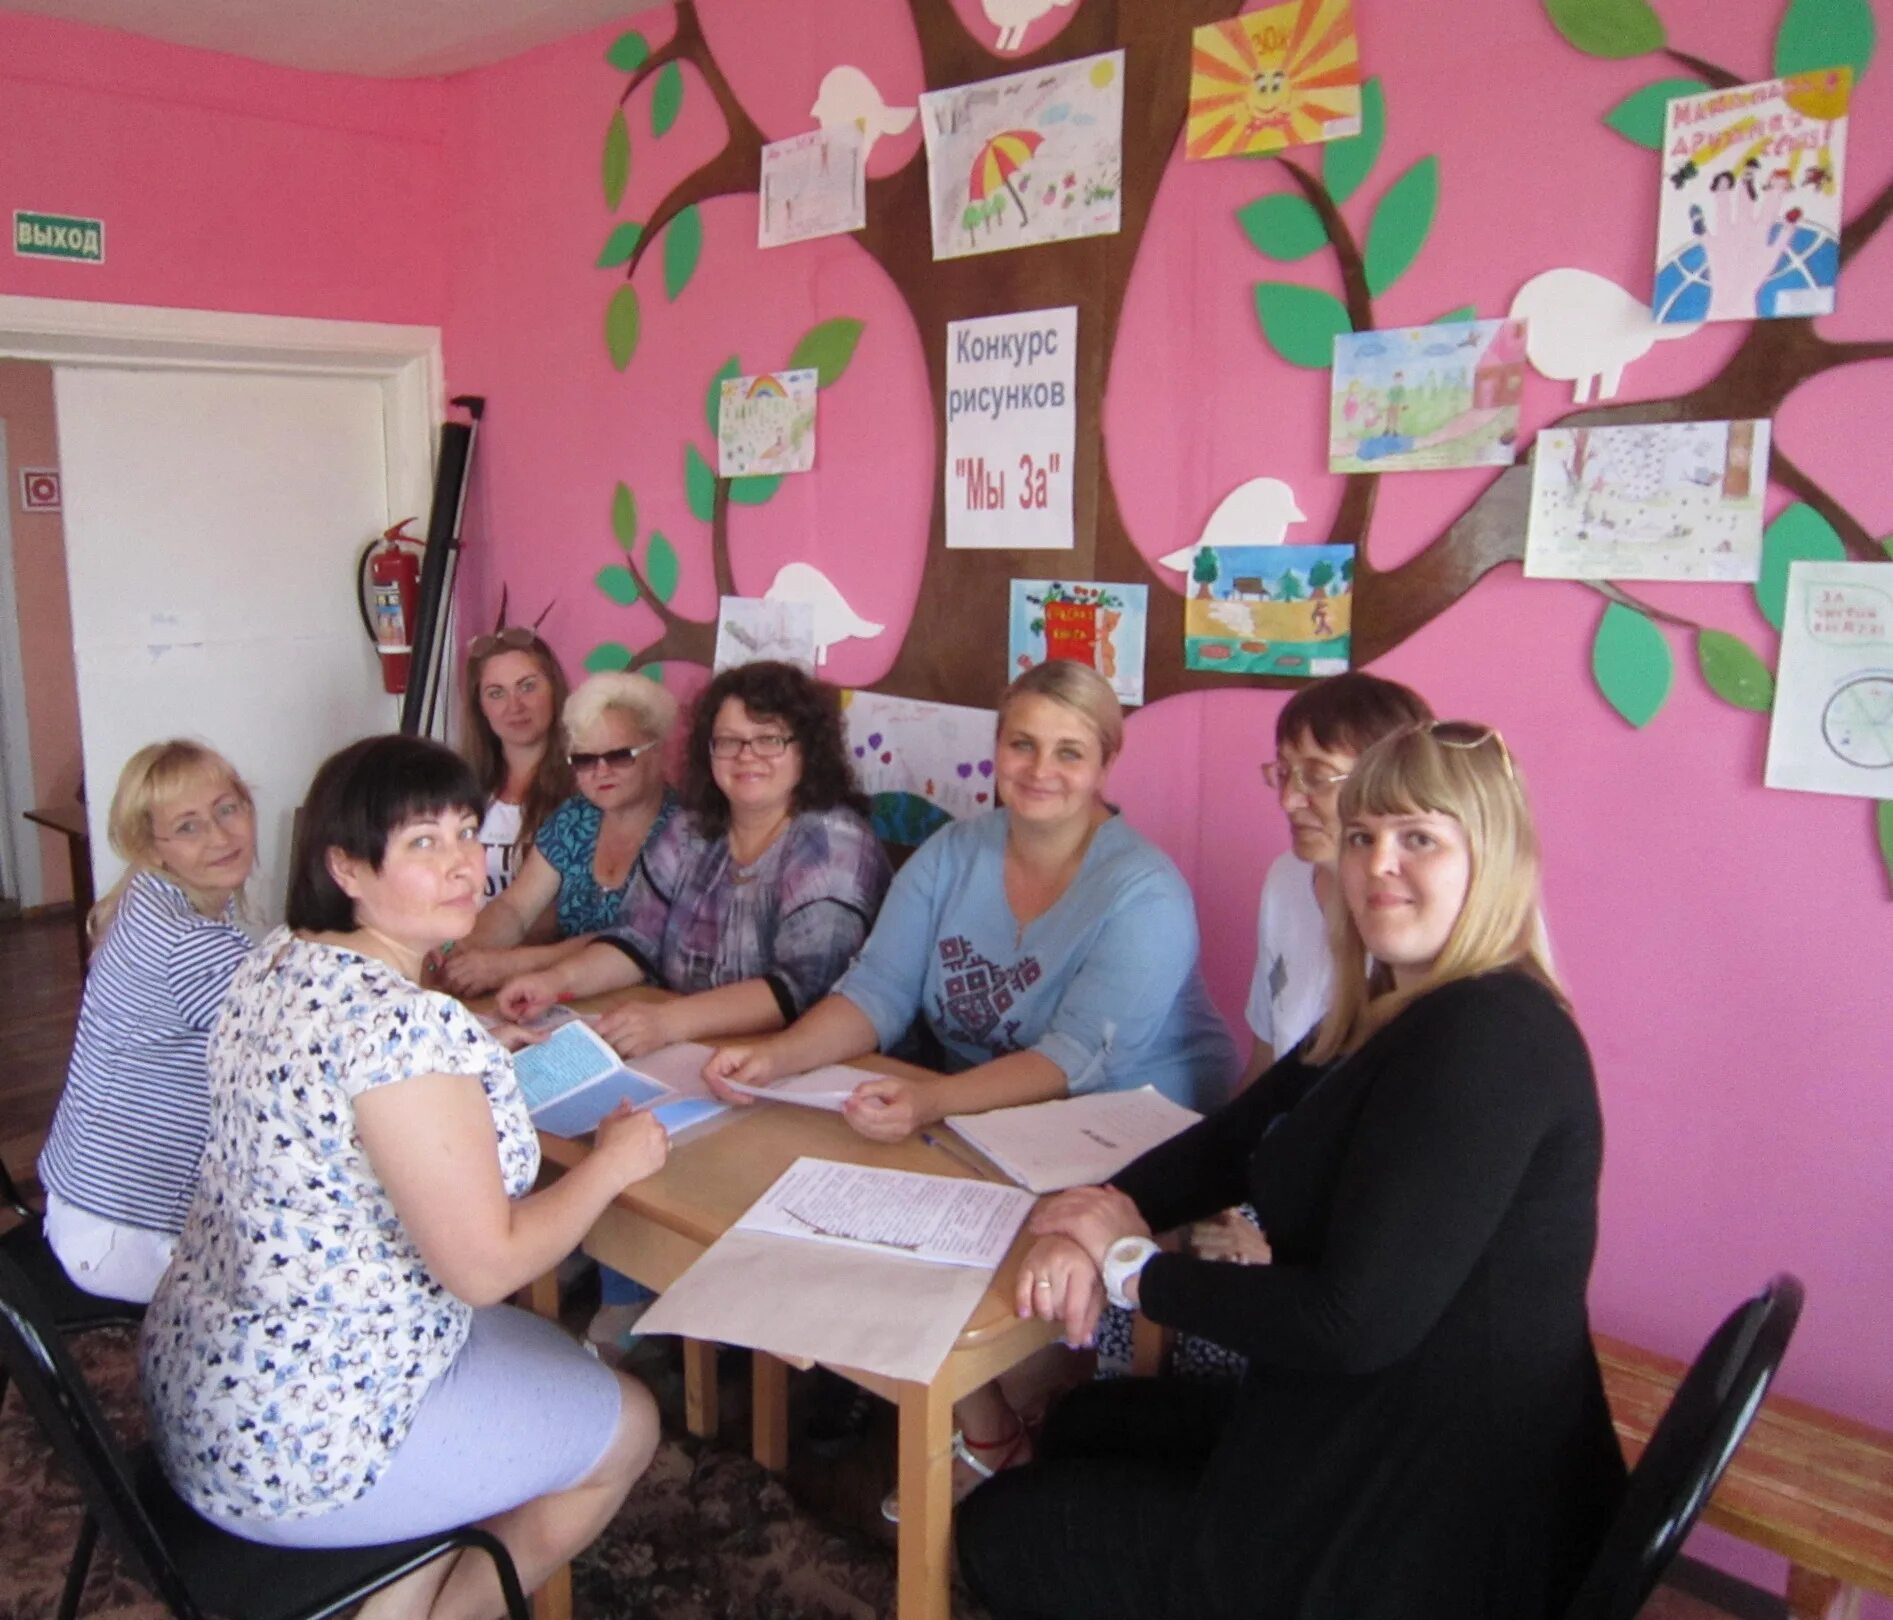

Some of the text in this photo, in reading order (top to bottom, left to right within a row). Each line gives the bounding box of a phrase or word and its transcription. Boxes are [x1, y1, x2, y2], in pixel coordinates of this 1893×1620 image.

[18, 221, 99, 256] ВЫХОД
[956, 328, 1059, 368] Конкурс
[949, 380, 1066, 422] рисунков
[956, 453, 1060, 511] "Мы За"
